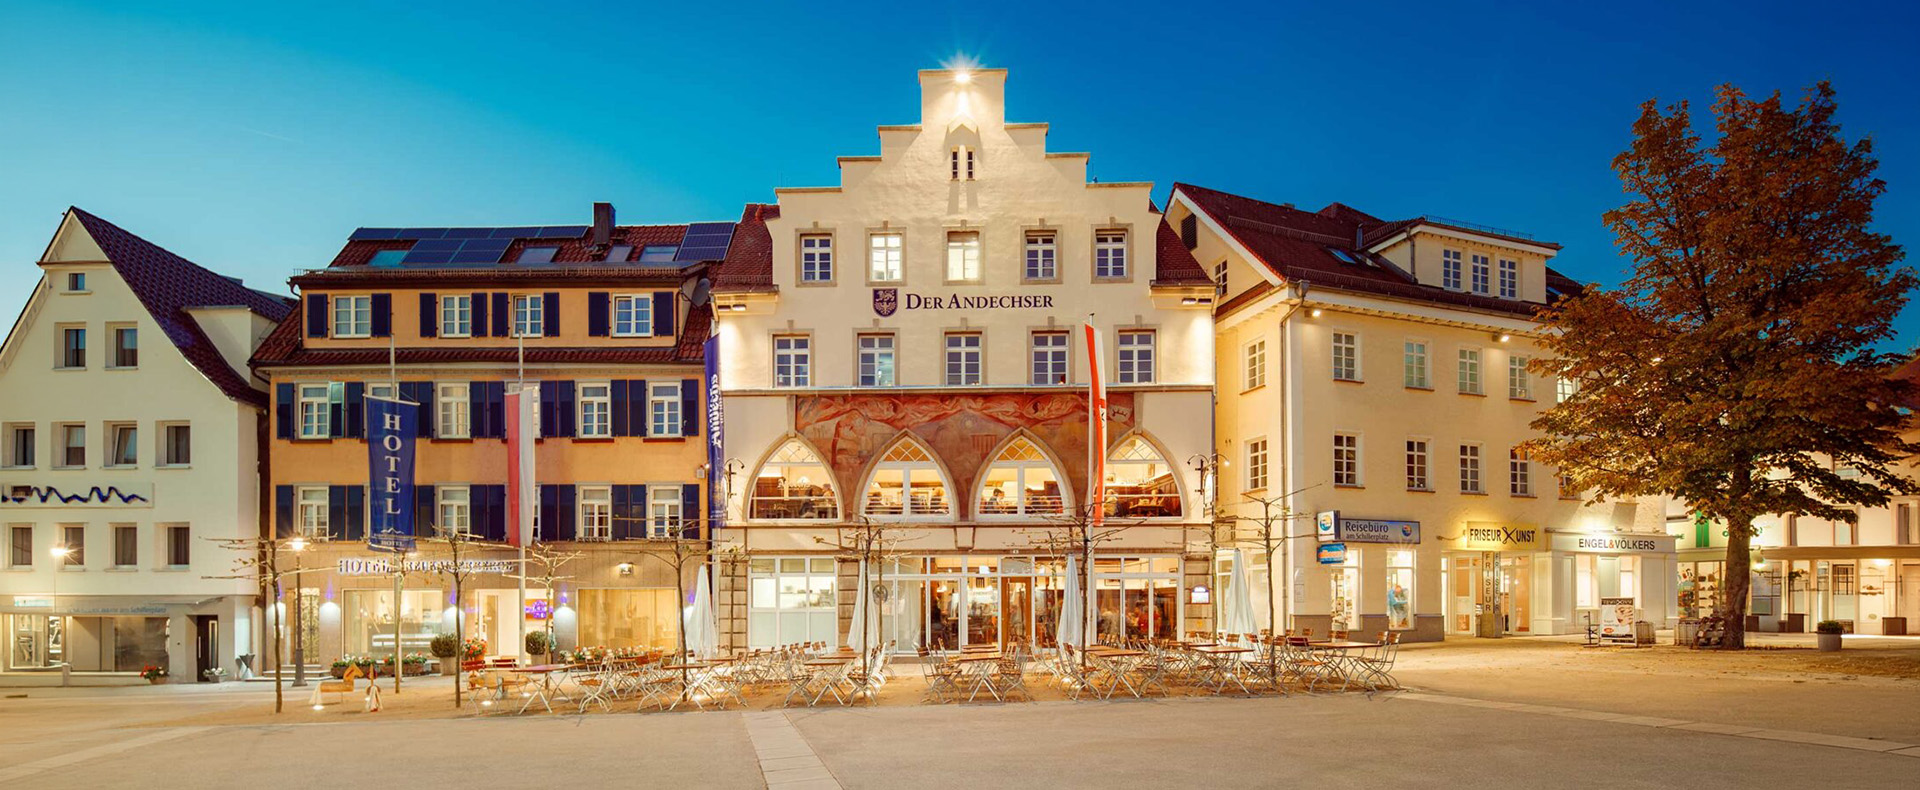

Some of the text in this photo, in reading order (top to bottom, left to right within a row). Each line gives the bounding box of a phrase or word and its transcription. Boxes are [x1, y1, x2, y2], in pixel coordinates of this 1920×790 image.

[906, 293, 1054, 309] DER ANDECHSER
[382, 412, 402, 515] HOTEL
[1345, 521, 1389, 533] Reisebüro
[1356, 532, 1389, 541] Schillerplatz
